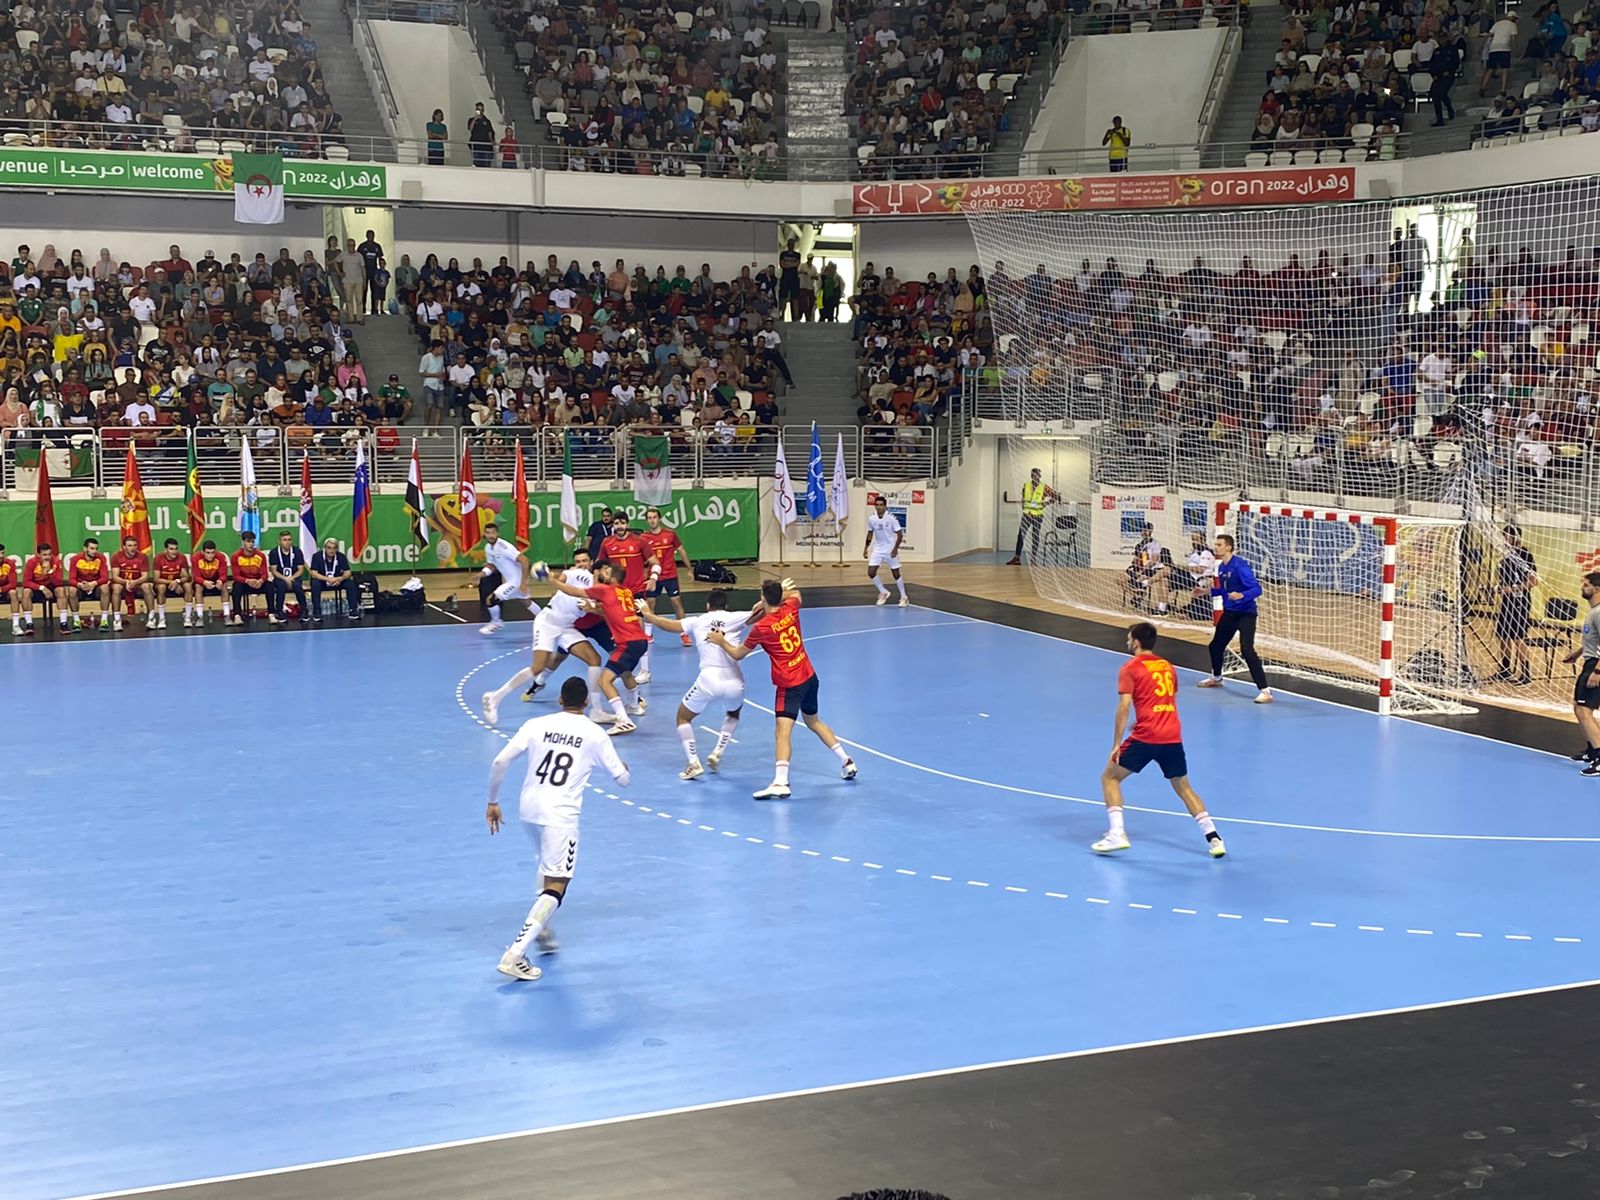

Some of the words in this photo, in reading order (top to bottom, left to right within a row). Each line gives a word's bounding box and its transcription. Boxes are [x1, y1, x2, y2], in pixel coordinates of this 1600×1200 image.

[60, 159, 125, 179] مرحبا
[132, 163, 204, 180] welcome
[299, 172, 328, 184] 2022
[329, 170, 382, 192] وهران
[1210, 179, 1264, 196] oran
[1266, 180, 1295, 191] 2022
[1296, 173, 1350, 195] وهران
[1001, 198, 1025, 208] 2022
[661, 495, 741, 529] وهران
[780, 625, 801, 653] 63
[1152, 671, 1174, 697] 36
[543, 731, 583, 749] MOHAB
[535, 749, 574, 787] 48
